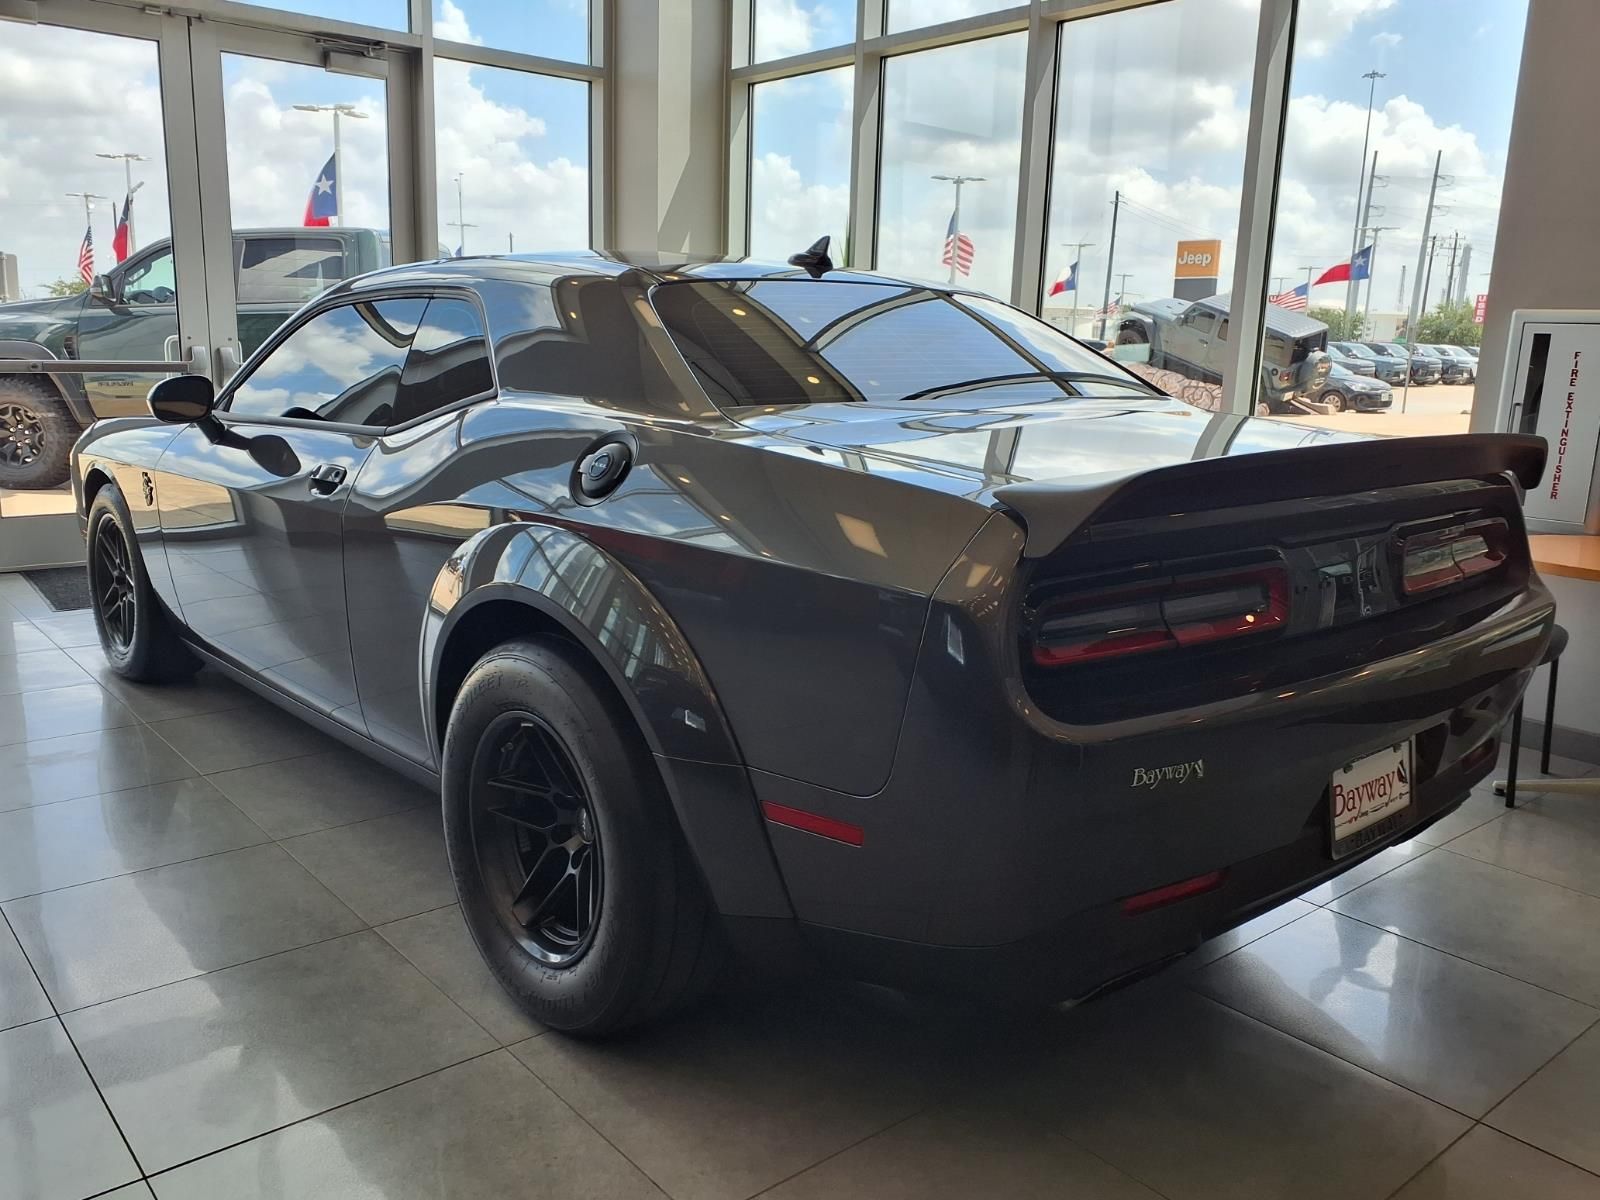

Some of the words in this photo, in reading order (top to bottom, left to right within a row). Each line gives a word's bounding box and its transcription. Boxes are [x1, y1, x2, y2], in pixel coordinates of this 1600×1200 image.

[1178, 251, 1211, 267] Jeep
[1475, 295, 1487, 322] USED
[1570, 351, 1581, 387] FIRE
[1550, 392, 1575, 500] EXTINGUISHER
[1130, 761, 1196, 790] Bayway
[1332, 770, 1396, 820] Bayway
